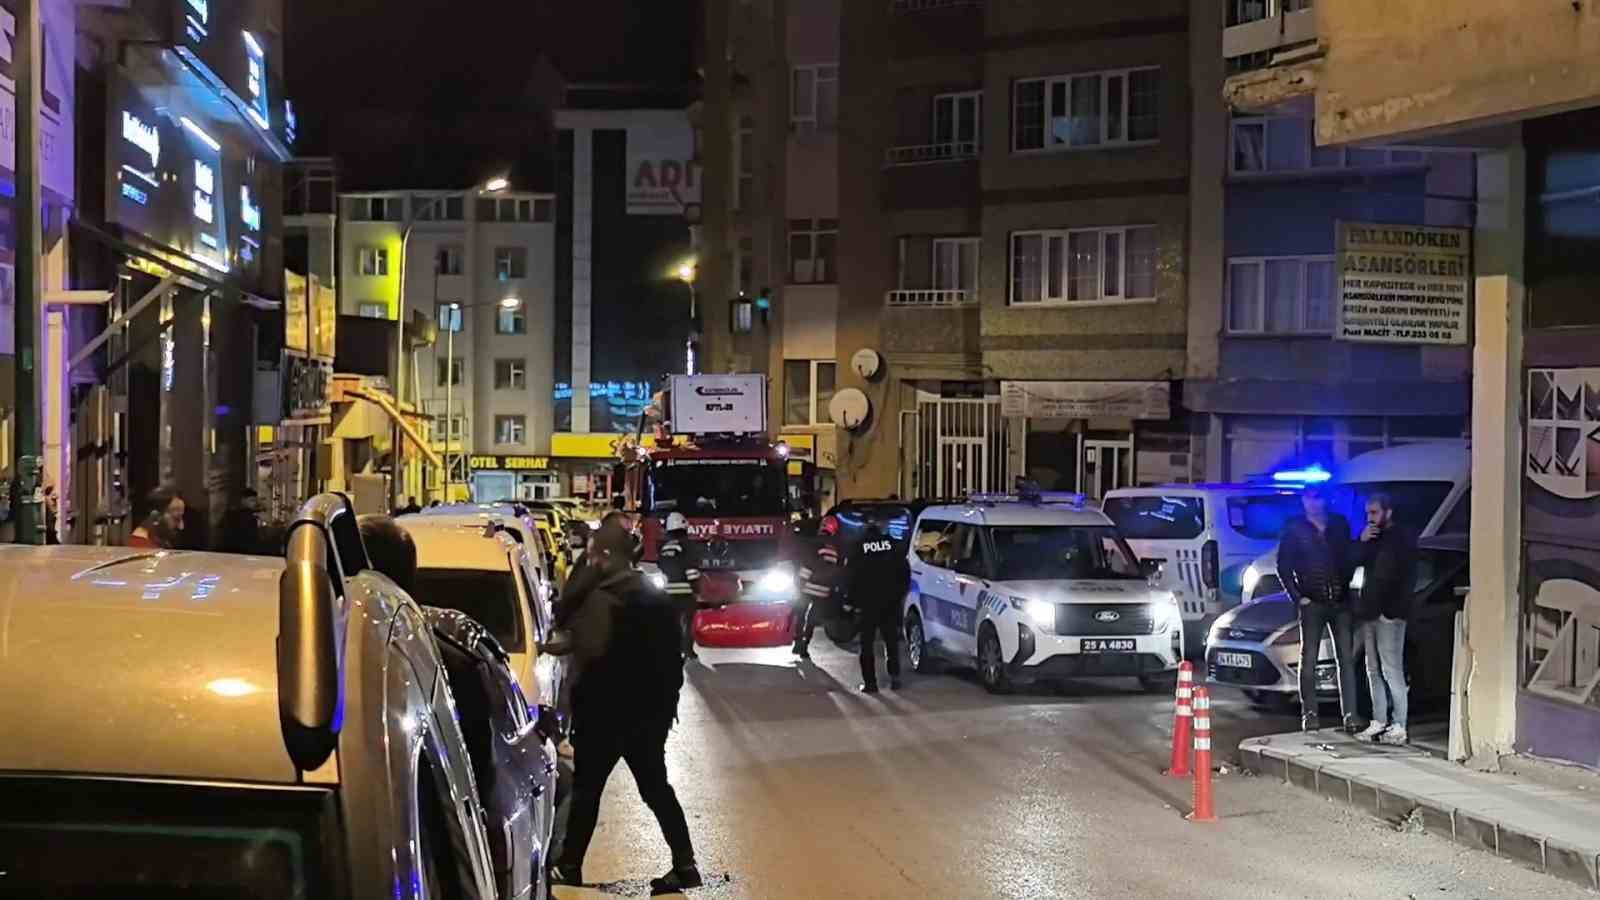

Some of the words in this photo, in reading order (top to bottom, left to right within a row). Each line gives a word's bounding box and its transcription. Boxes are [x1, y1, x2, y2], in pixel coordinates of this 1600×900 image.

[1349, 228, 1460, 249] PALANDÖKEN
[505, 457, 548, 469] SERHAT
[1084, 640, 1097, 650] 25
[1099, 640, 1107, 650] A
